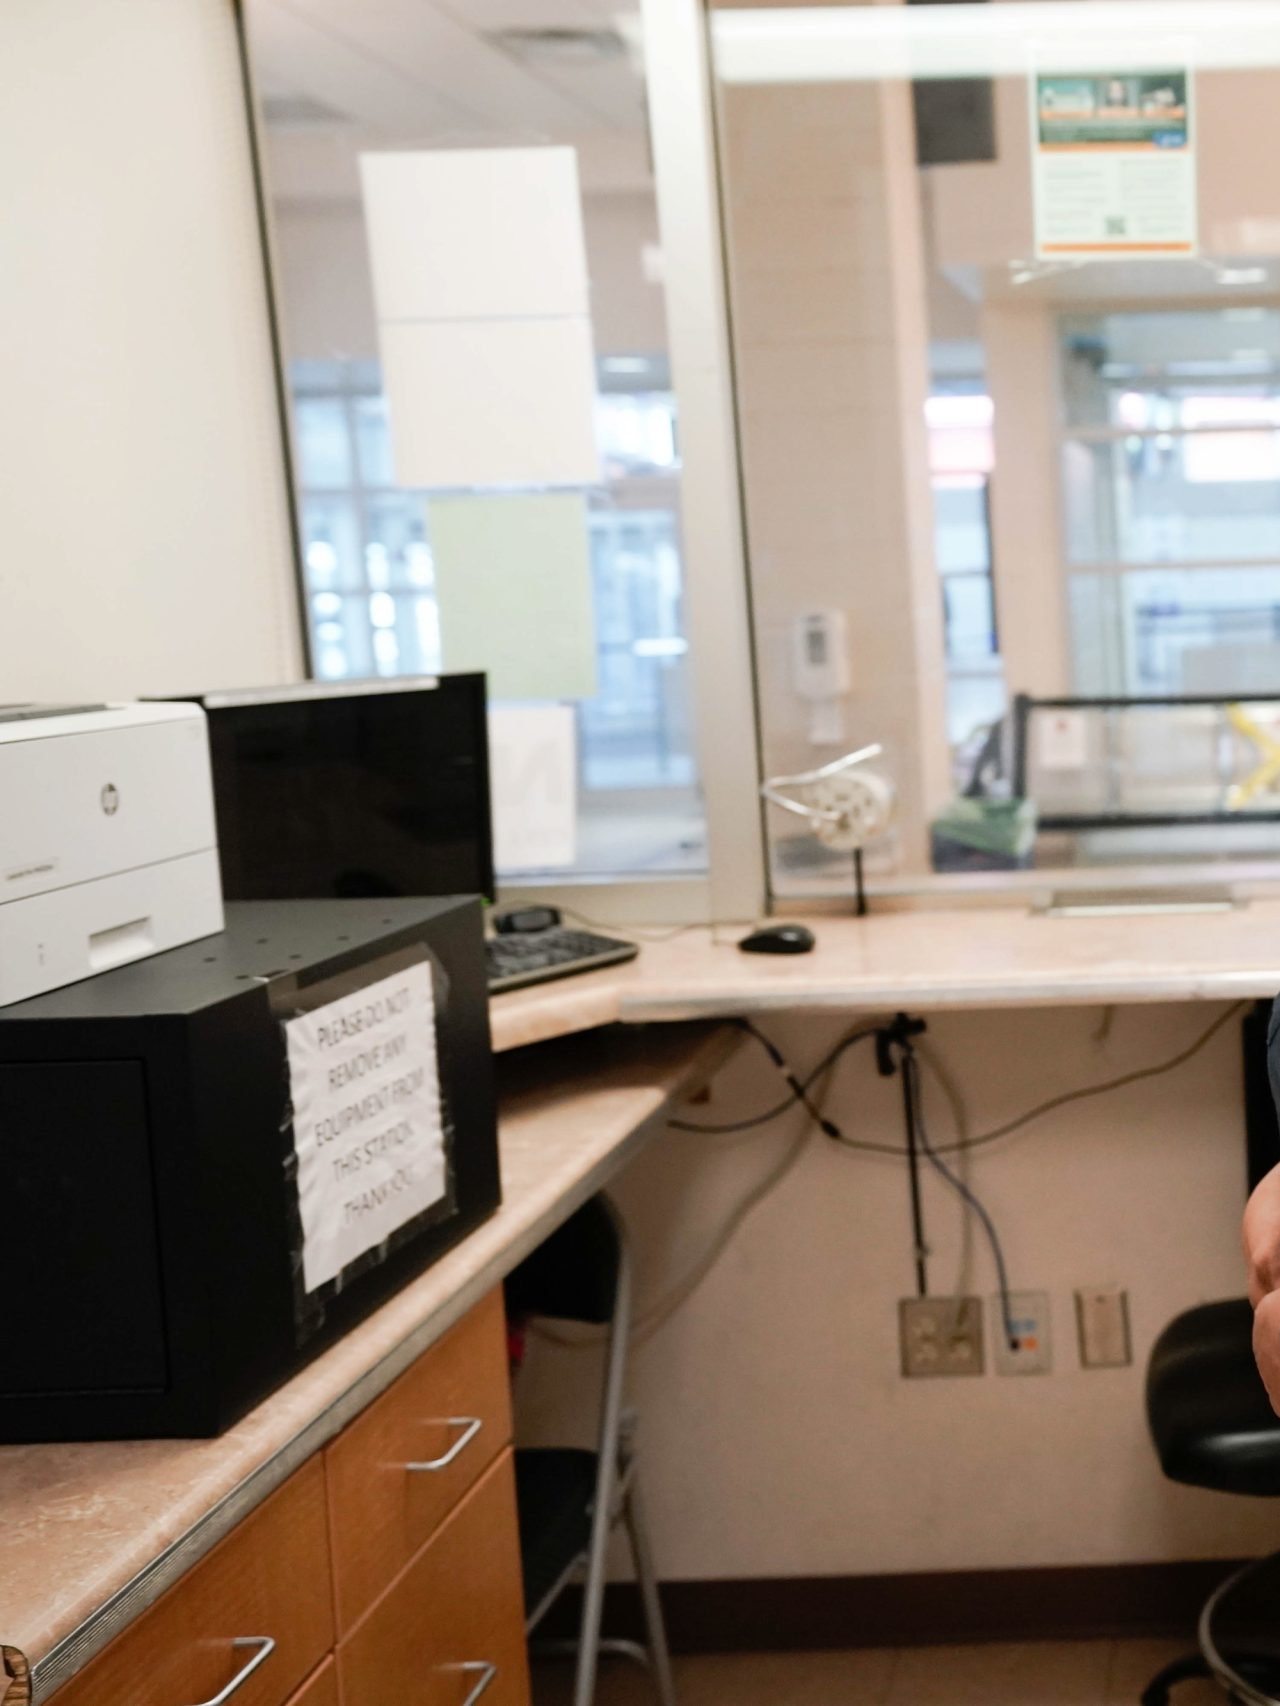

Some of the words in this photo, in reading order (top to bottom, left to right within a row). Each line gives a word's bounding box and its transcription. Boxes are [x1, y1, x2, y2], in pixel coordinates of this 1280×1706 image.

[317, 1007, 363, 1052] PLEASE
[365, 1001, 385, 1029] DO
[385, 987, 410, 1016] NOT
[328, 1045, 382, 1093] REMOVE
[383, 1032, 407, 1063] ANY
[314, 1085, 389, 1147] EQUIPMENT
[392, 1066, 424, 1103] FROM
[332, 1147, 362, 1183] THIS
[364, 1120, 415, 1166] STATION
[344, 1182, 387, 1225] THANK
